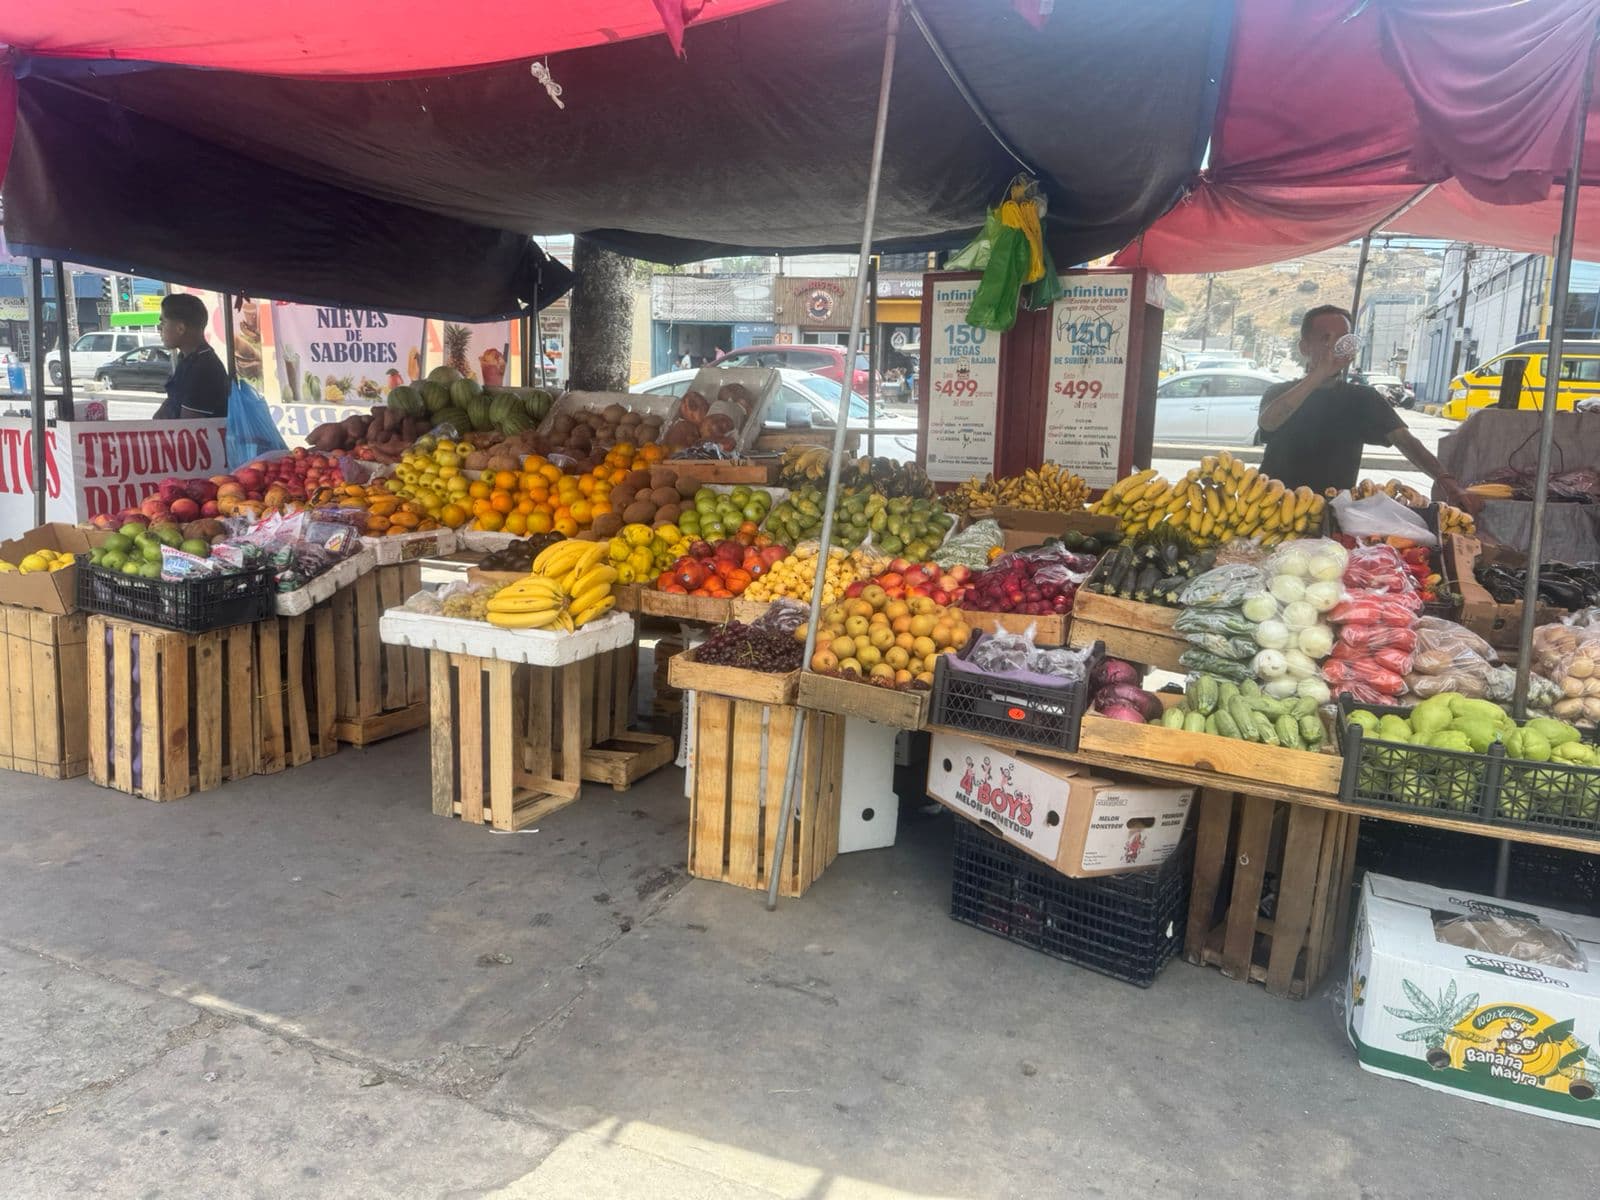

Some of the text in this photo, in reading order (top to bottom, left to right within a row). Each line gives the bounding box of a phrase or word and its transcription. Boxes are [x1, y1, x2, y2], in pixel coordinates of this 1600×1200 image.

[937, 289, 977, 301] infinit
[1063, 286, 1128, 297] nfinitum
[317, 308, 389, 329] NIEVES
[345, 330, 362, 342] DE
[944, 324, 986, 344] 150
[1066, 321, 1112, 343] 150
[310, 342, 398, 363] SABORES
[949, 346, 981, 356] MEGAS
[1072, 345, 1105, 355] MEGAS
[935, 380, 978, 397] $499
[1054, 380, 1102, 399] $499
[79, 428, 211, 482] TEJUINOS
[960, 768, 1034, 827] 4 BOYS
[955, 791, 1034, 840] MELON HONEYDEW
[1465, 954, 1544, 977] Banana
[1465, 1047, 1524, 1072] Banana
[1489, 1064, 1539, 1087] Mayra
